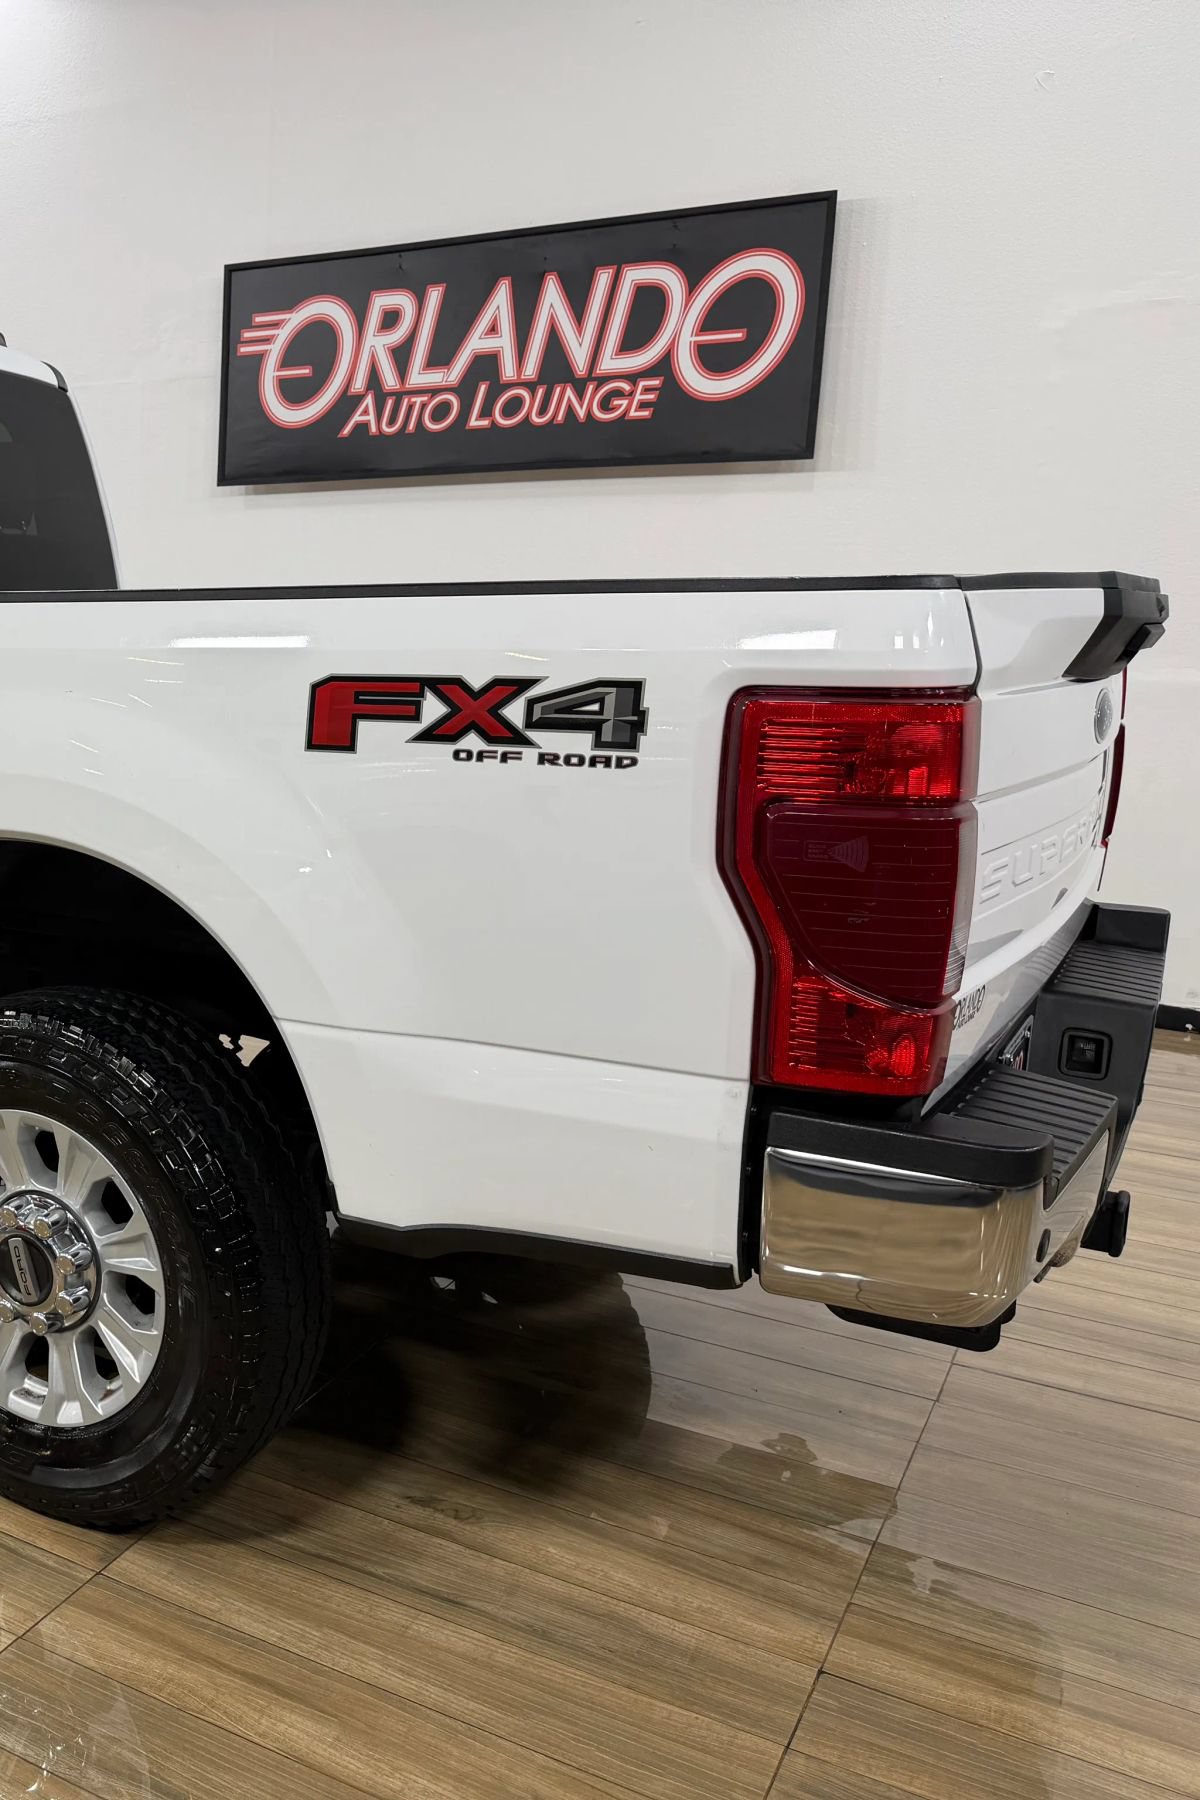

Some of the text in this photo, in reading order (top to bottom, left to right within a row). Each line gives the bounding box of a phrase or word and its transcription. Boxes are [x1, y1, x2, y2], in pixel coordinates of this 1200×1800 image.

[237, 247, 805, 429] ORLANDO
[338, 376, 663, 438] AUTO LOUNGE
[304, 673, 650, 753] FX4
[452, 748, 639, 770] OFF ROAD
[13, 1244, 32, 1297] FORD
